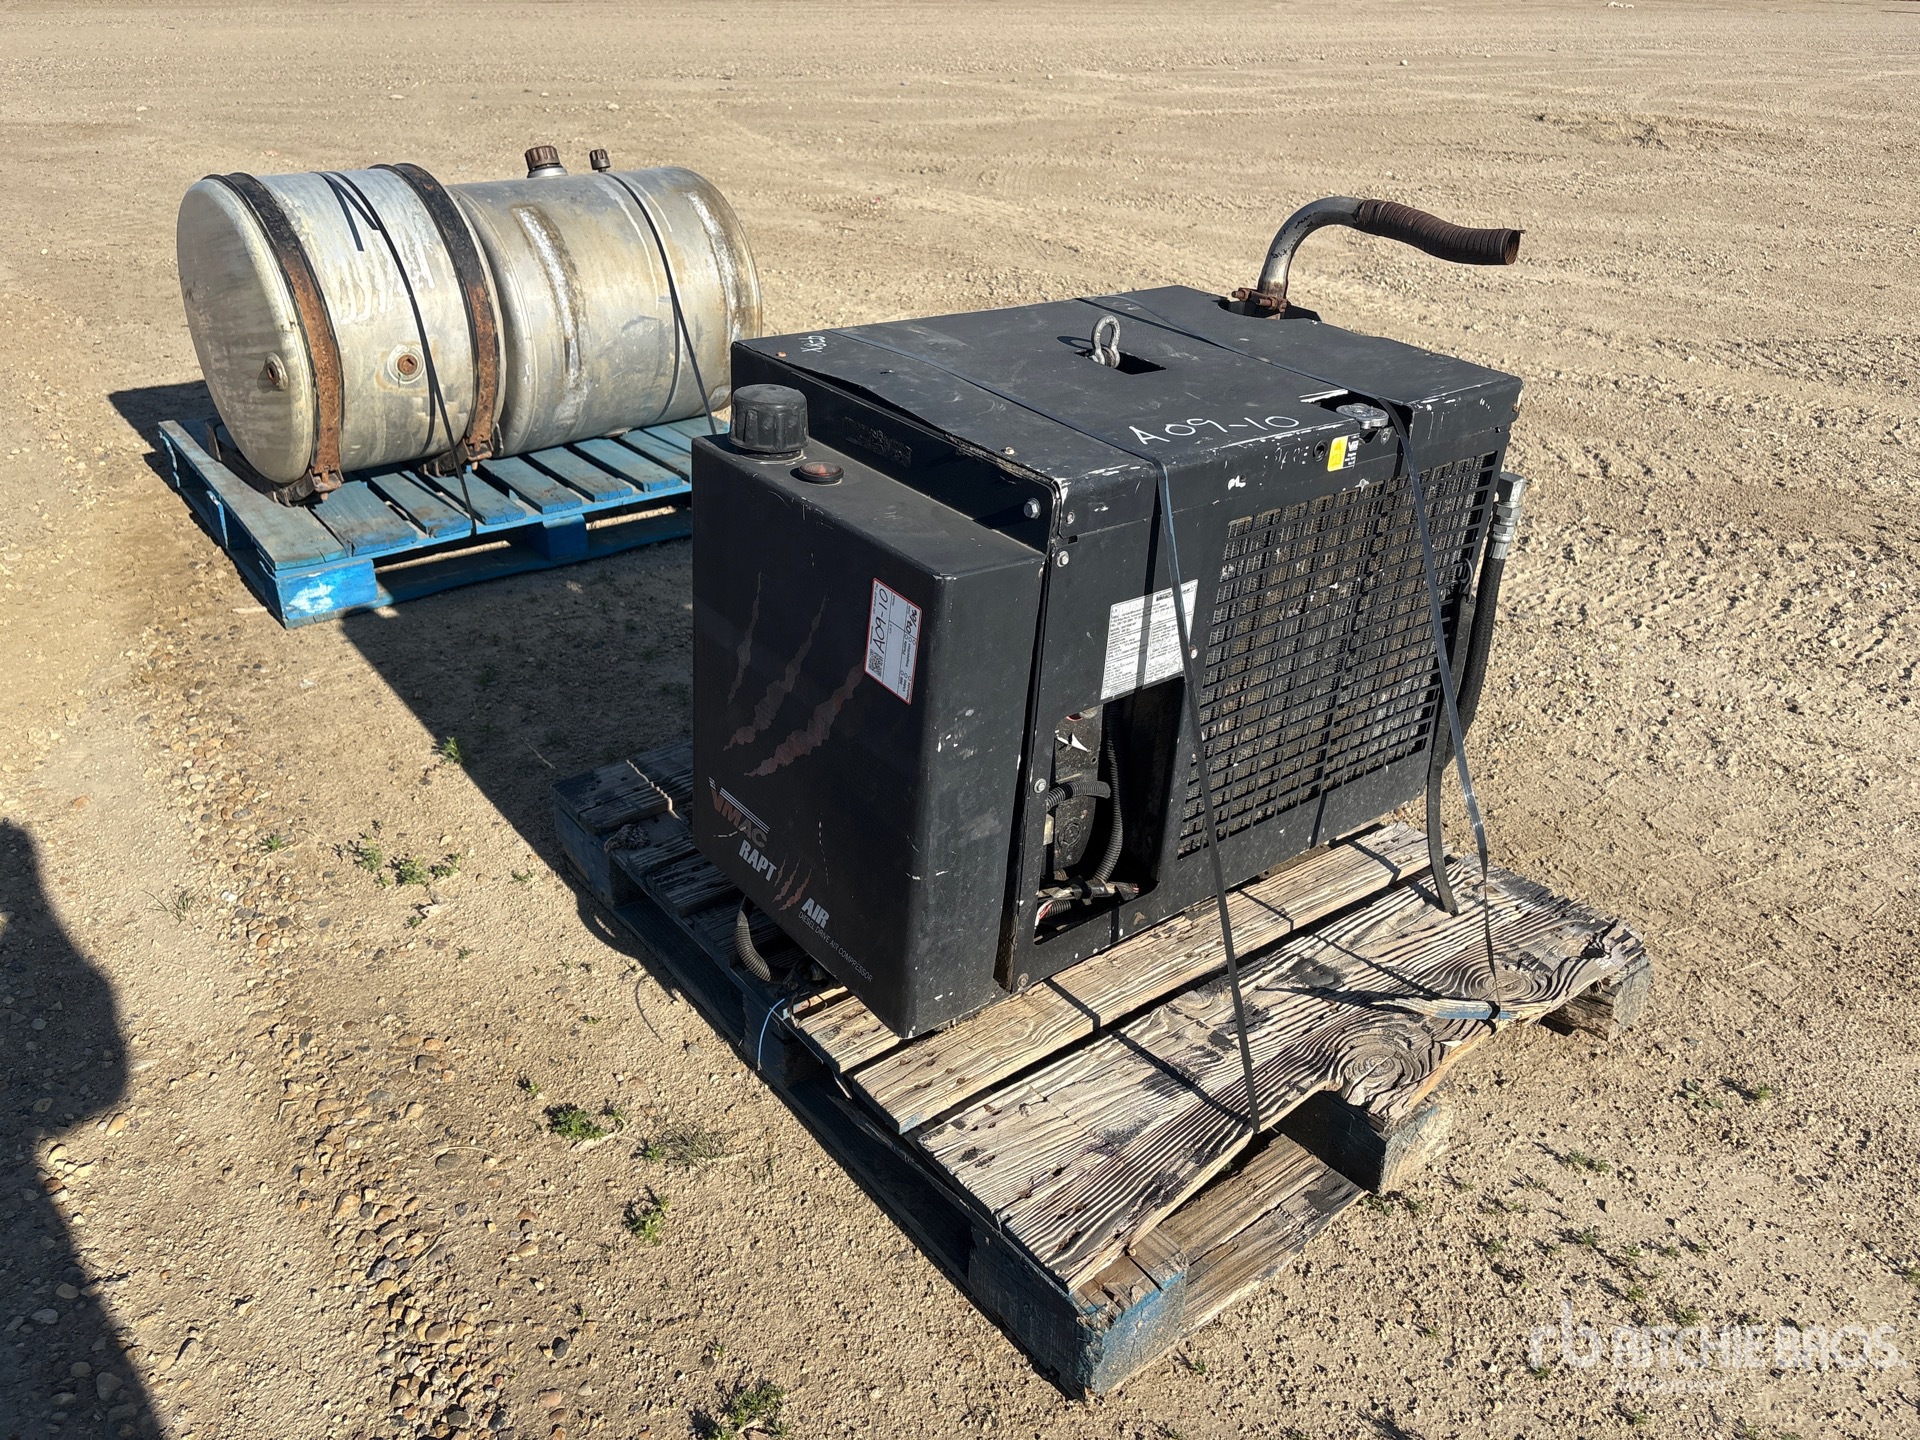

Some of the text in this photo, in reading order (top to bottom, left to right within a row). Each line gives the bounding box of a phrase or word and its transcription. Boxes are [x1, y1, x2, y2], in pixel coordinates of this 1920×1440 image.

[1128, 415, 1300, 445] A09-10
[872, 588, 888, 654] A09-10
[710, 788, 768, 848] VMAC
[801, 897, 830, 929] AIR
[798, 911, 873, 982] DIESEL DRIVE AIR COMPRESSOR
